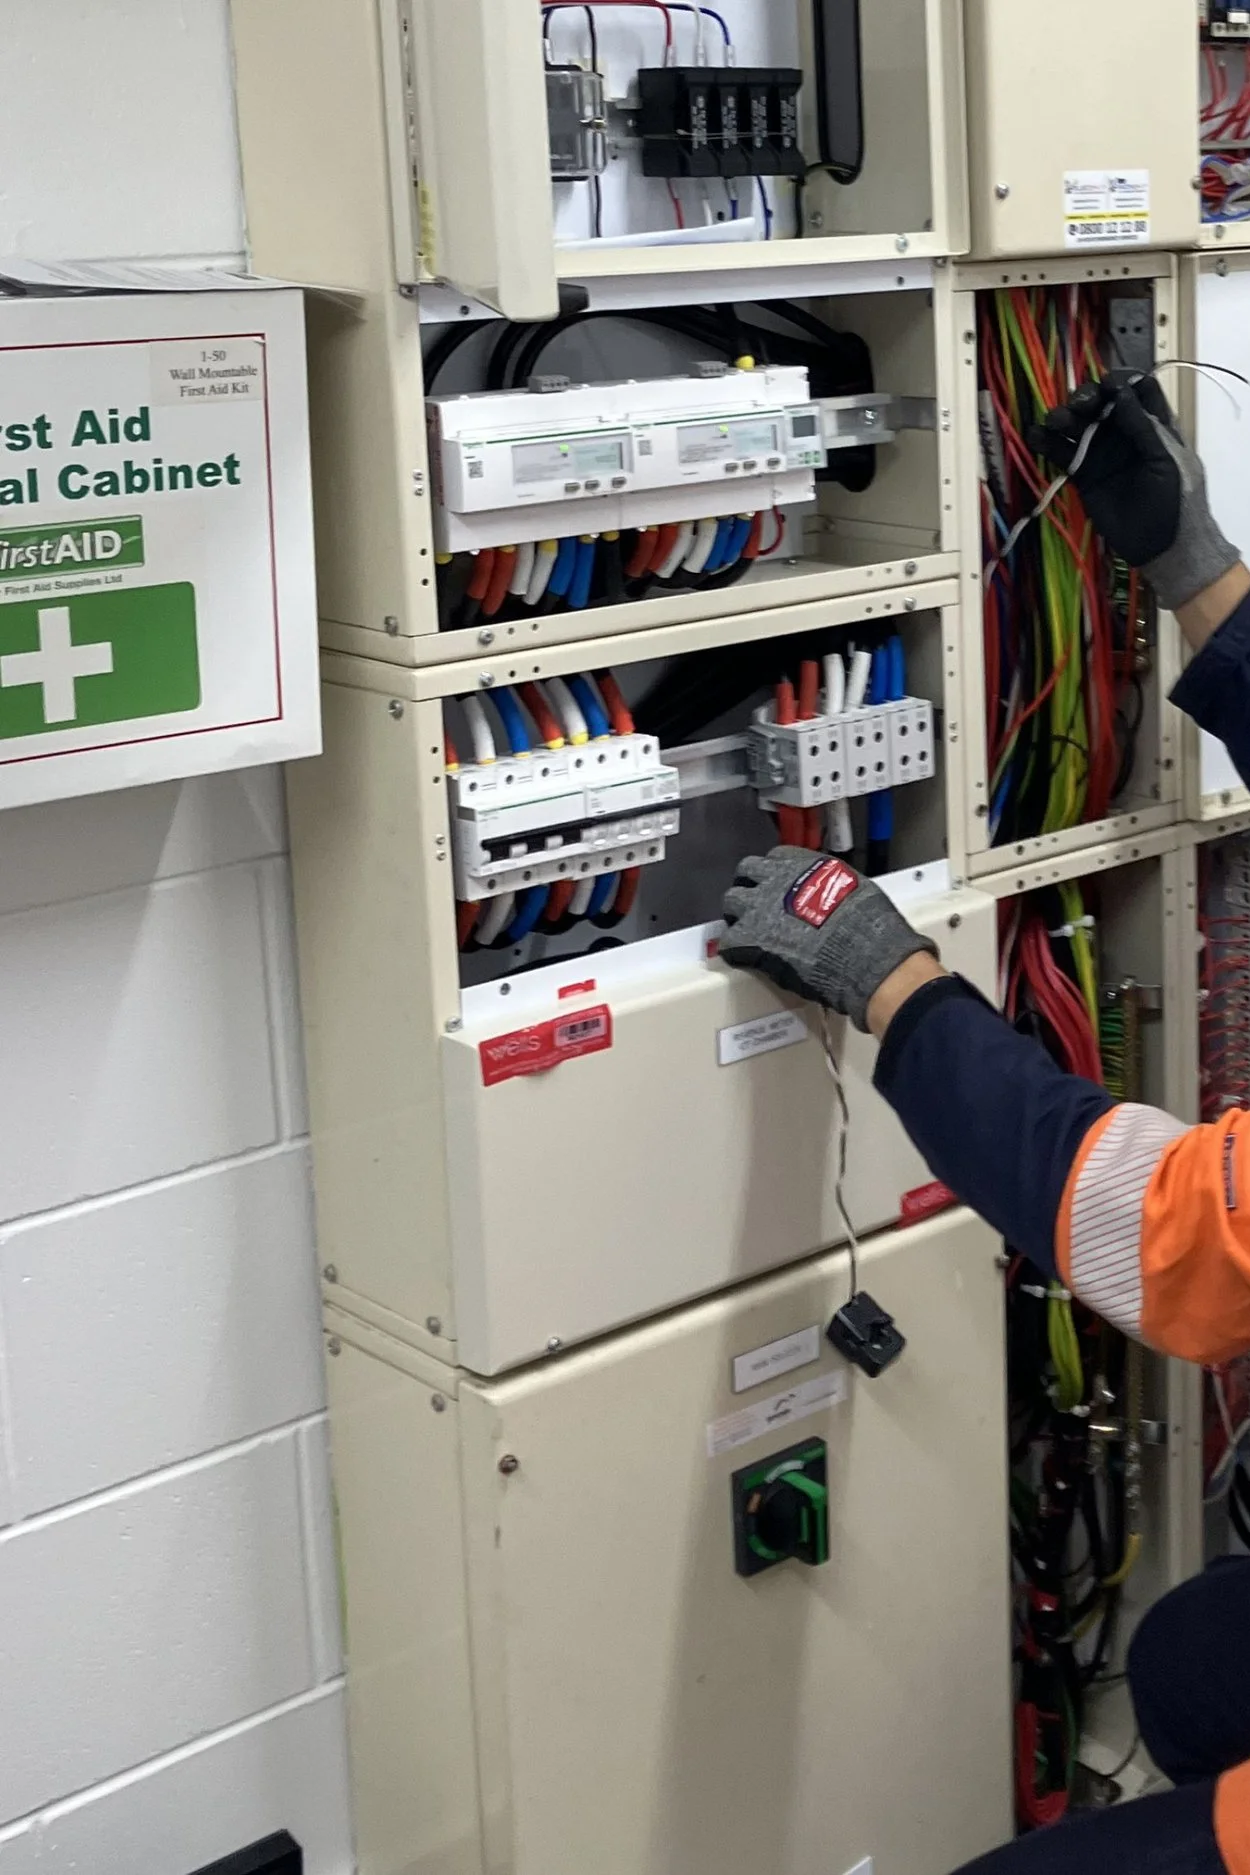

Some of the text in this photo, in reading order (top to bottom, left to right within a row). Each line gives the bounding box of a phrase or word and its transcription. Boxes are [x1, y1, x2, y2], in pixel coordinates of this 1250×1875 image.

[201, 350, 226, 362] 1-50
[168, 365, 258, 380] Wall Mountable
[179, 382, 249, 397] First Aid Kit
[0, 406, 151, 451] st Aid
[58, 453, 241, 500] Cabinet
[0, 529, 122, 570] irstAID
[5, 574, 123, 595] First Aid Supplies Ltd
